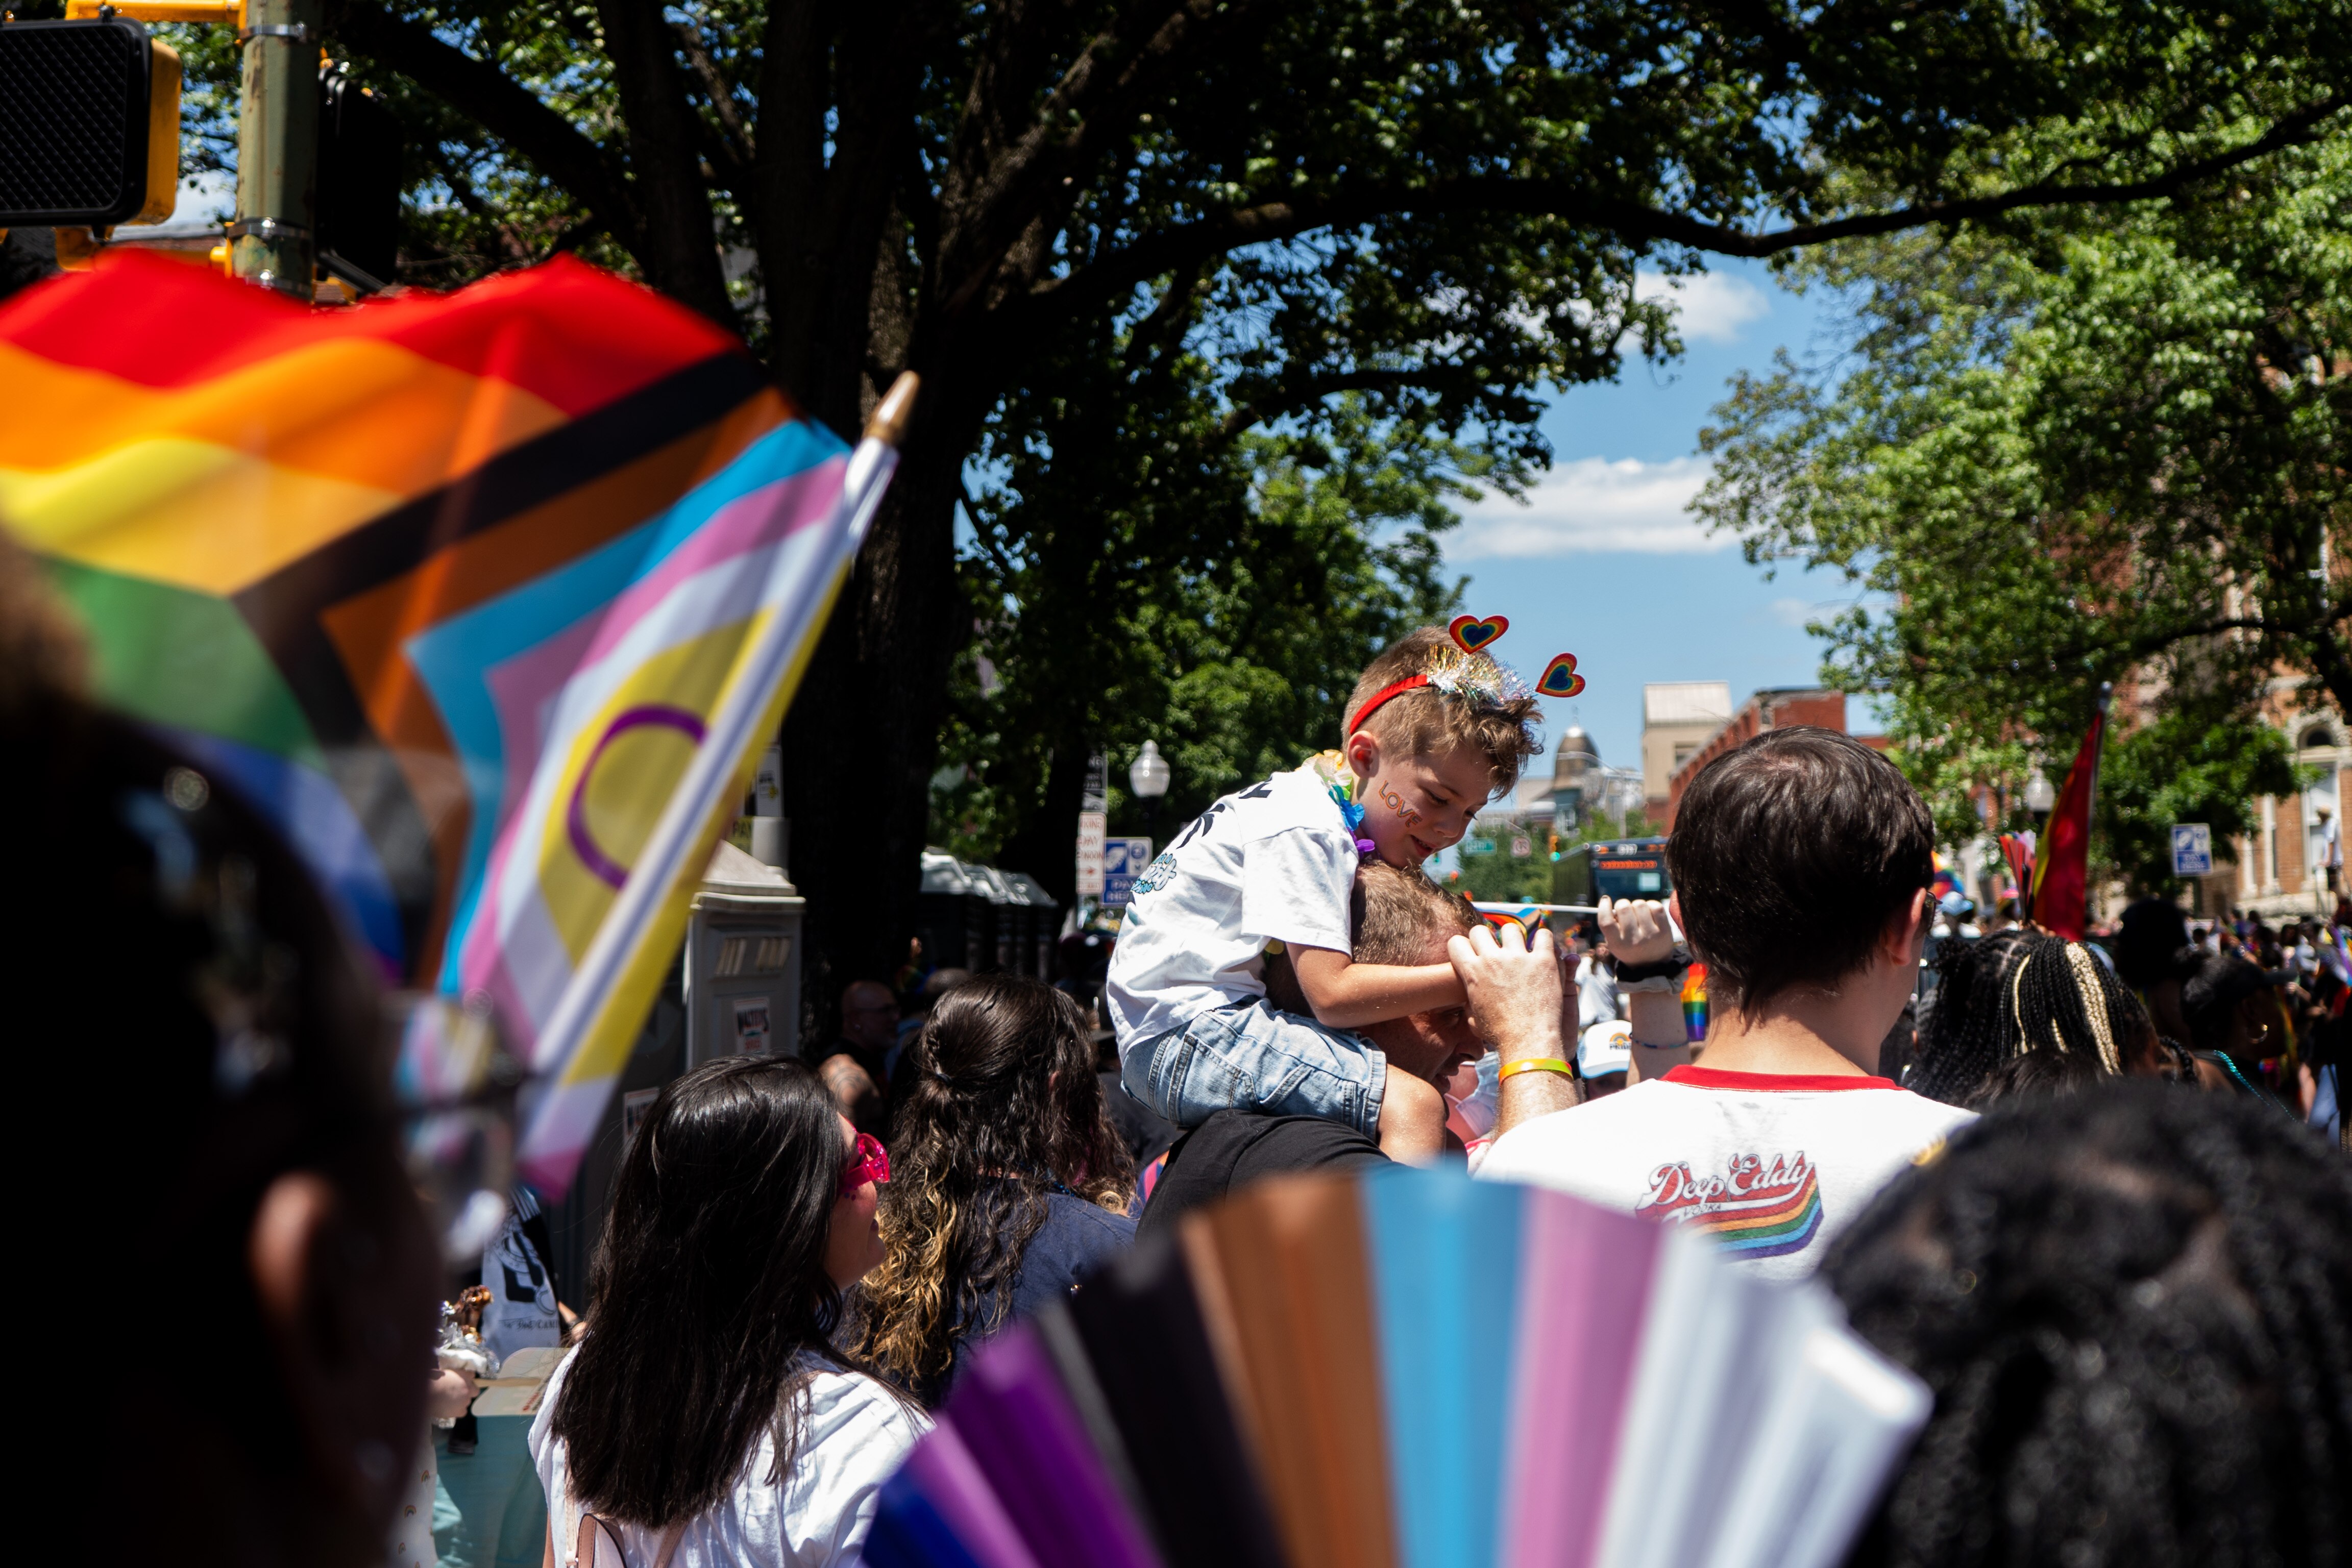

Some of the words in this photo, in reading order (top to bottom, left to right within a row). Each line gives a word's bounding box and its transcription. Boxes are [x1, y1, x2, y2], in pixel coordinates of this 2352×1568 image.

[1379, 780, 1422, 828] LOVE
[1636, 1161, 1725, 1208] Deep
[1727, 1150, 1816, 1199] Eddy
[1683, 1203, 1721, 1217] VODKA
